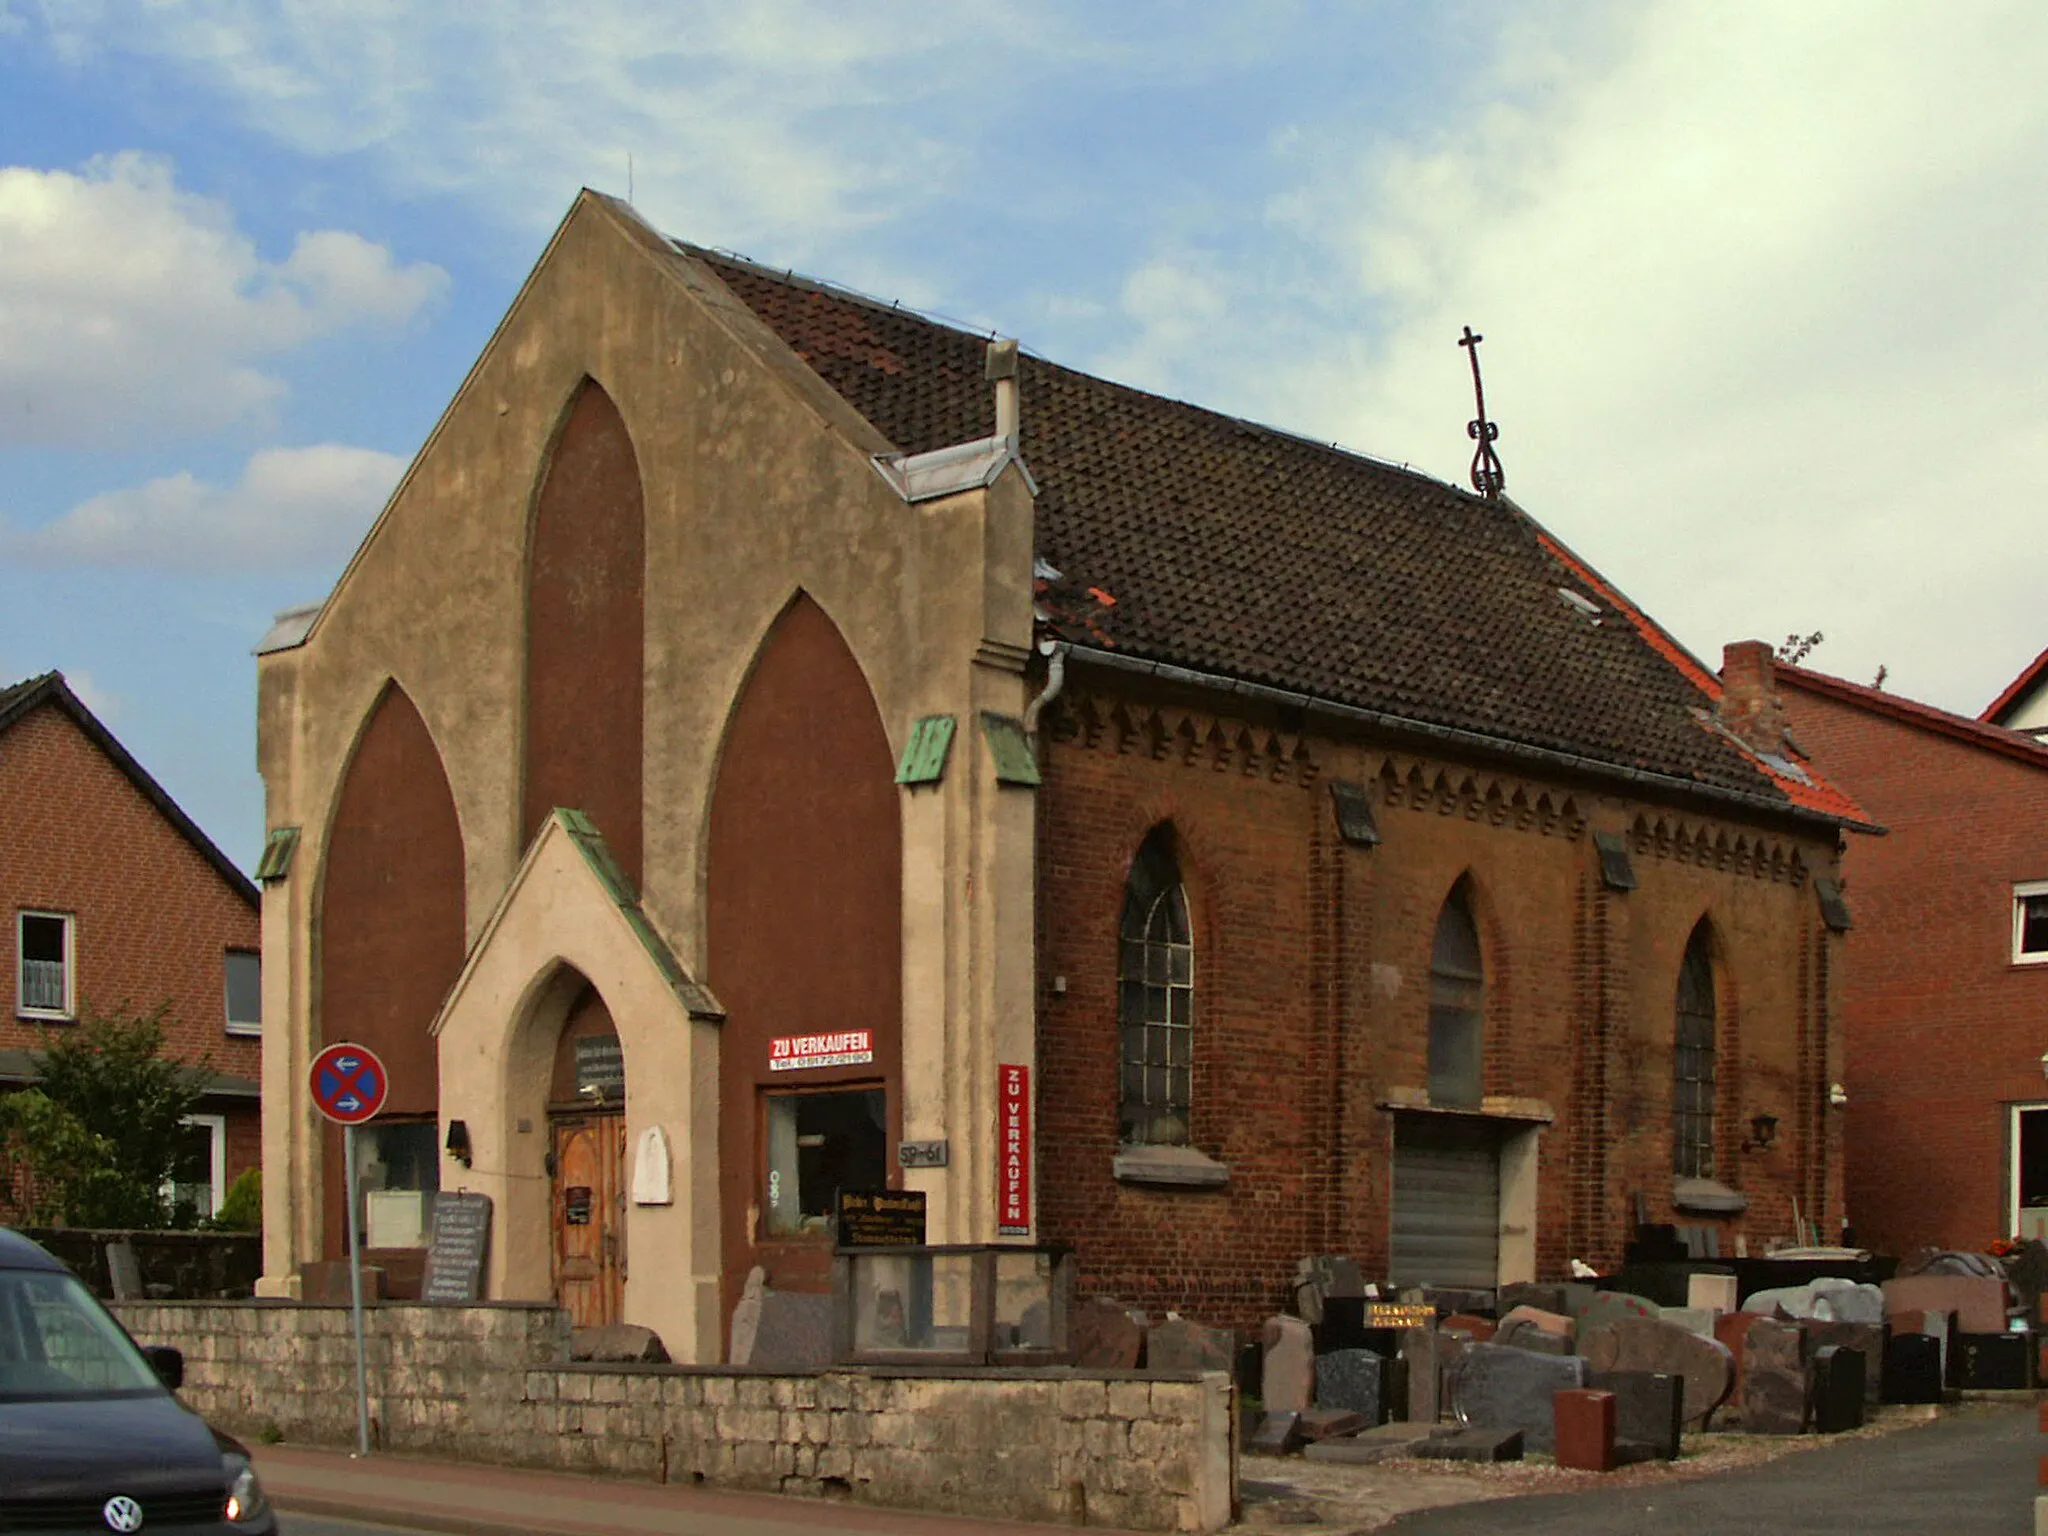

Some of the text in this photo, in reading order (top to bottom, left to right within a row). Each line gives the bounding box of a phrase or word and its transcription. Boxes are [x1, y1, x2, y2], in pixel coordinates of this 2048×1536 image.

[773, 1032, 869, 1057] ZU VERKAUFEN
[1008, 1069, 1020, 1096] ZU
[1008, 1103, 1020, 1219] VERKAUFEN
